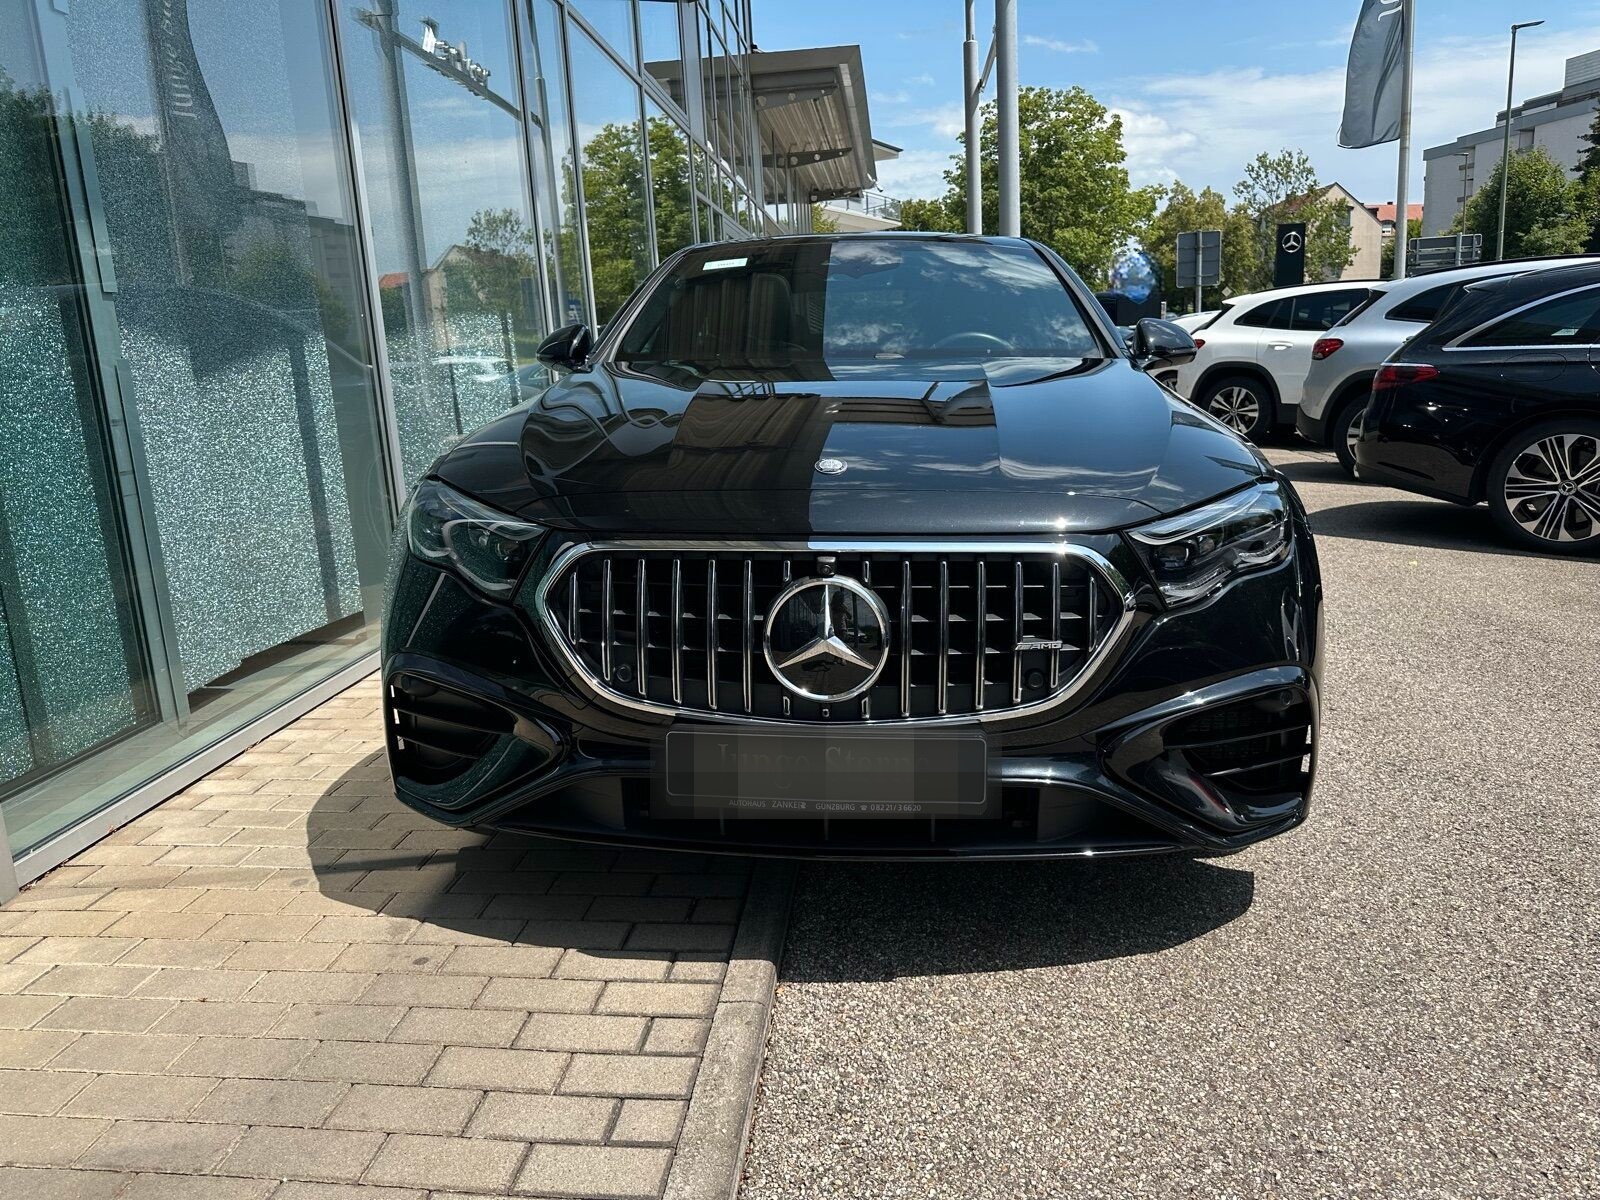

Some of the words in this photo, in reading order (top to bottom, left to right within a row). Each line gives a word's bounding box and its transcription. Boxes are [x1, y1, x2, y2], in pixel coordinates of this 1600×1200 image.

[1030, 640, 1063, 650] AMG
[717, 743, 810, 789] Junge
[825, 746, 931, 783] Sterne
[728, 799, 766, 808] AUTOHAUS
[815, 802, 856, 811] GÜNZBURG
